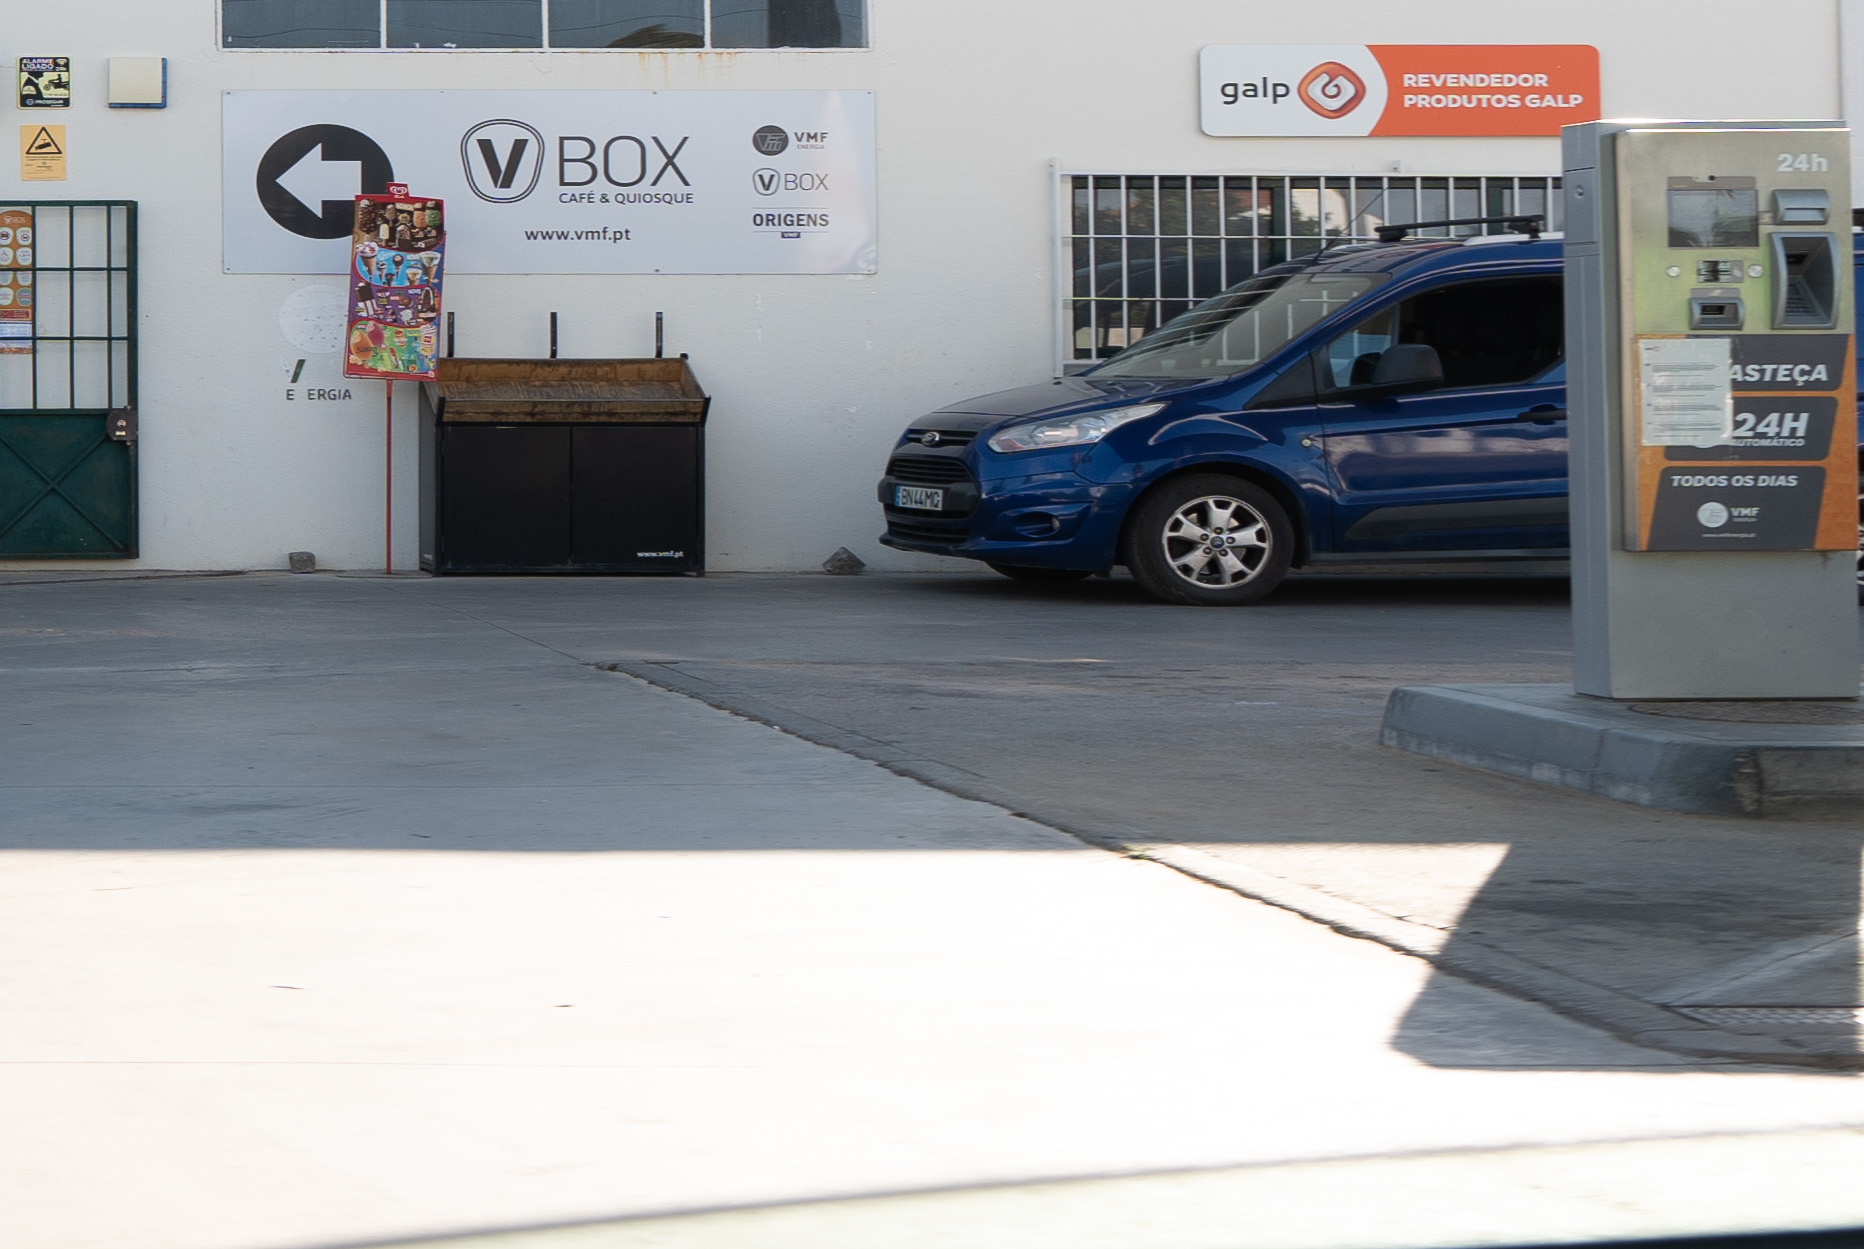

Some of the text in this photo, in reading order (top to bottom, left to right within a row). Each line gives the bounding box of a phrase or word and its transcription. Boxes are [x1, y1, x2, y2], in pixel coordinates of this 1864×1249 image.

[1403, 72, 1549, 88] REVENDEDOR
[1220, 75, 1291, 105] galp
[1403, 94, 1584, 109] PRODUTOS GALP
[794, 131, 829, 143] VMF
[557, 135, 691, 188] BOX
[1777, 153, 1829, 173] 24h
[784, 173, 829, 191] BOX
[558, 189, 694, 206] CAFÉ & QUIOSQUE
[752, 213, 830, 227] ORIGENS
[524, 226, 632, 244] www.vmf.pt
[1734, 412, 1811, 437] 24H
[1730, 436, 1806, 447] AUTOMÁTICO
[1670, 475, 1799, 487] TODOS OS DIAS
[1730, 507, 1761, 517] VMF
